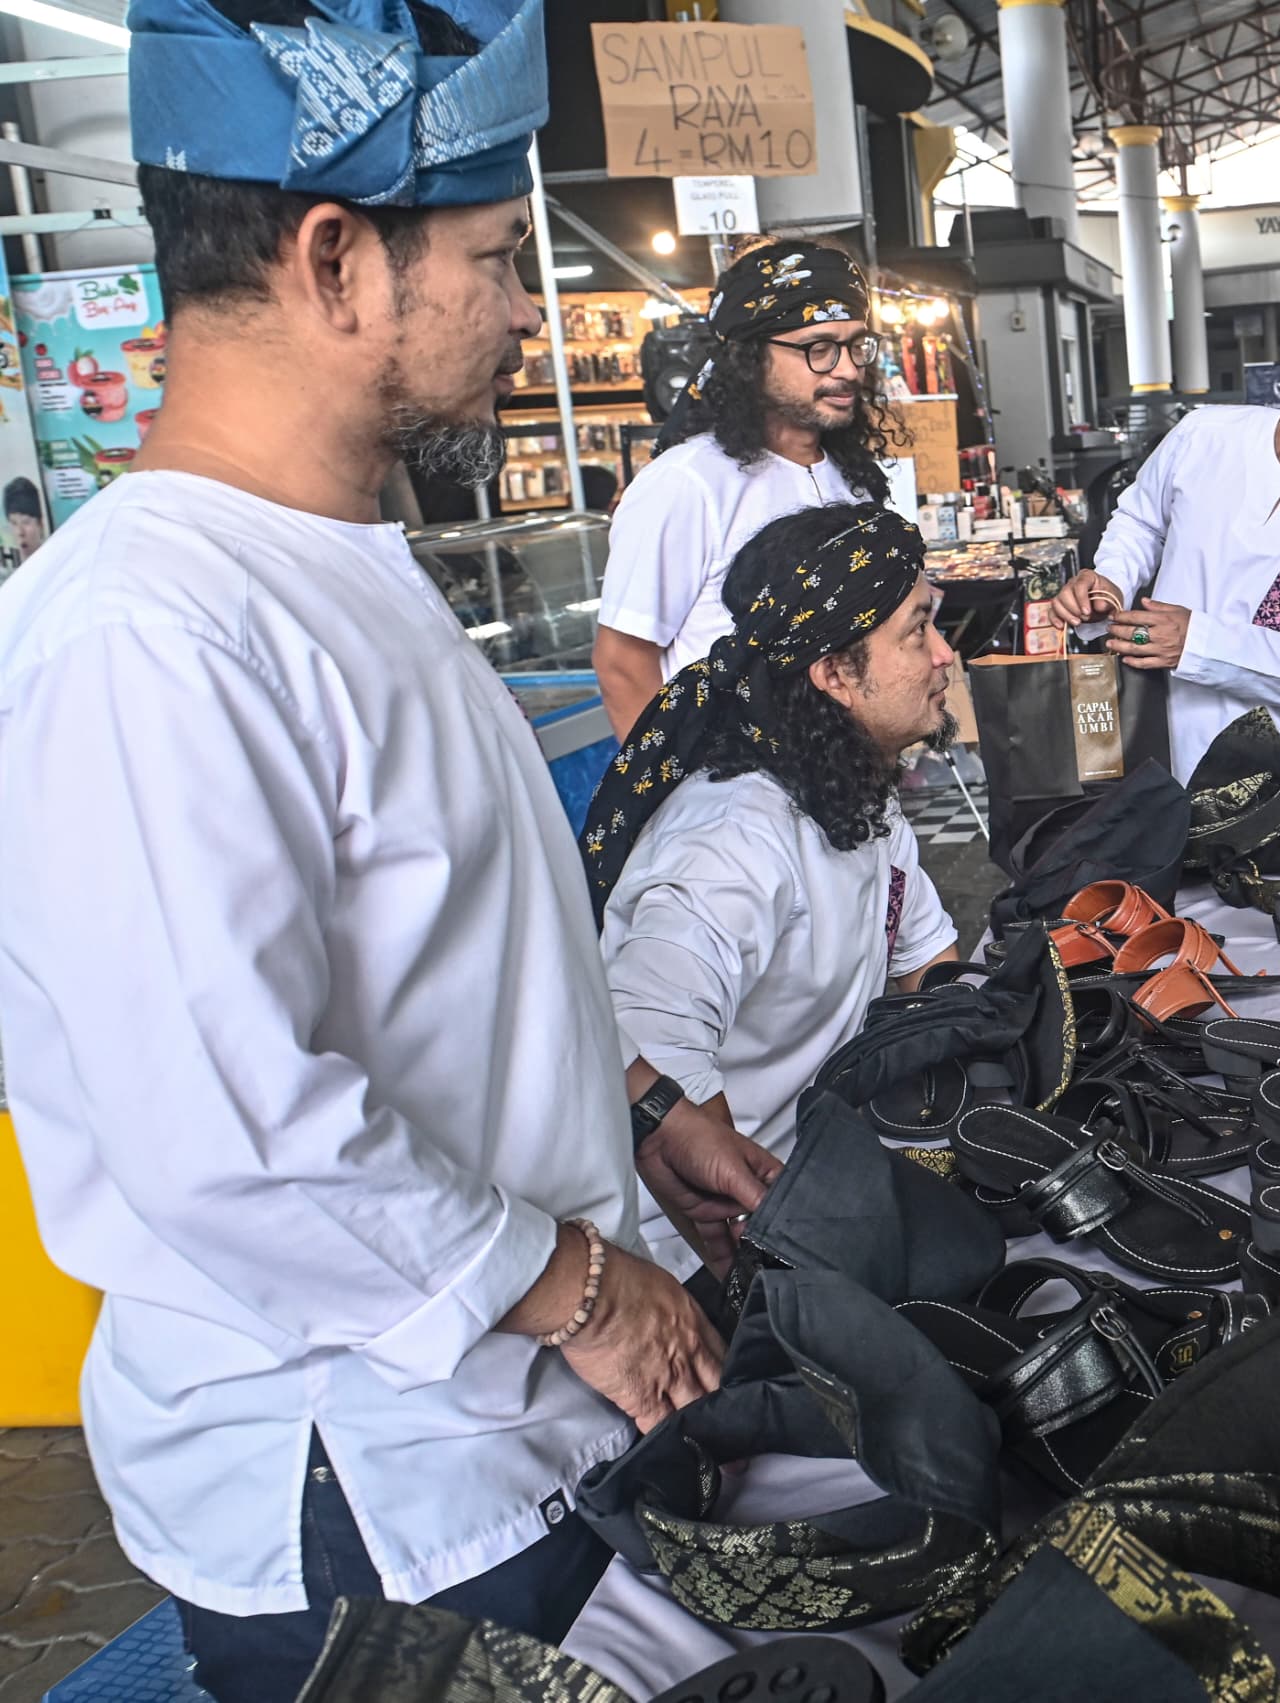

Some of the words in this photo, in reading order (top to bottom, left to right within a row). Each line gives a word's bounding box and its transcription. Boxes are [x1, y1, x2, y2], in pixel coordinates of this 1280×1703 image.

[602, 31, 783, 85] SAMPUL
[670, 84, 763, 130] RAYA
[710, 209, 737, 231] 10
[1077, 701, 1113, 714] CAPAL
[1078, 711, 1114, 724] AKAR
[1080, 721, 1114, 735] UMBI
